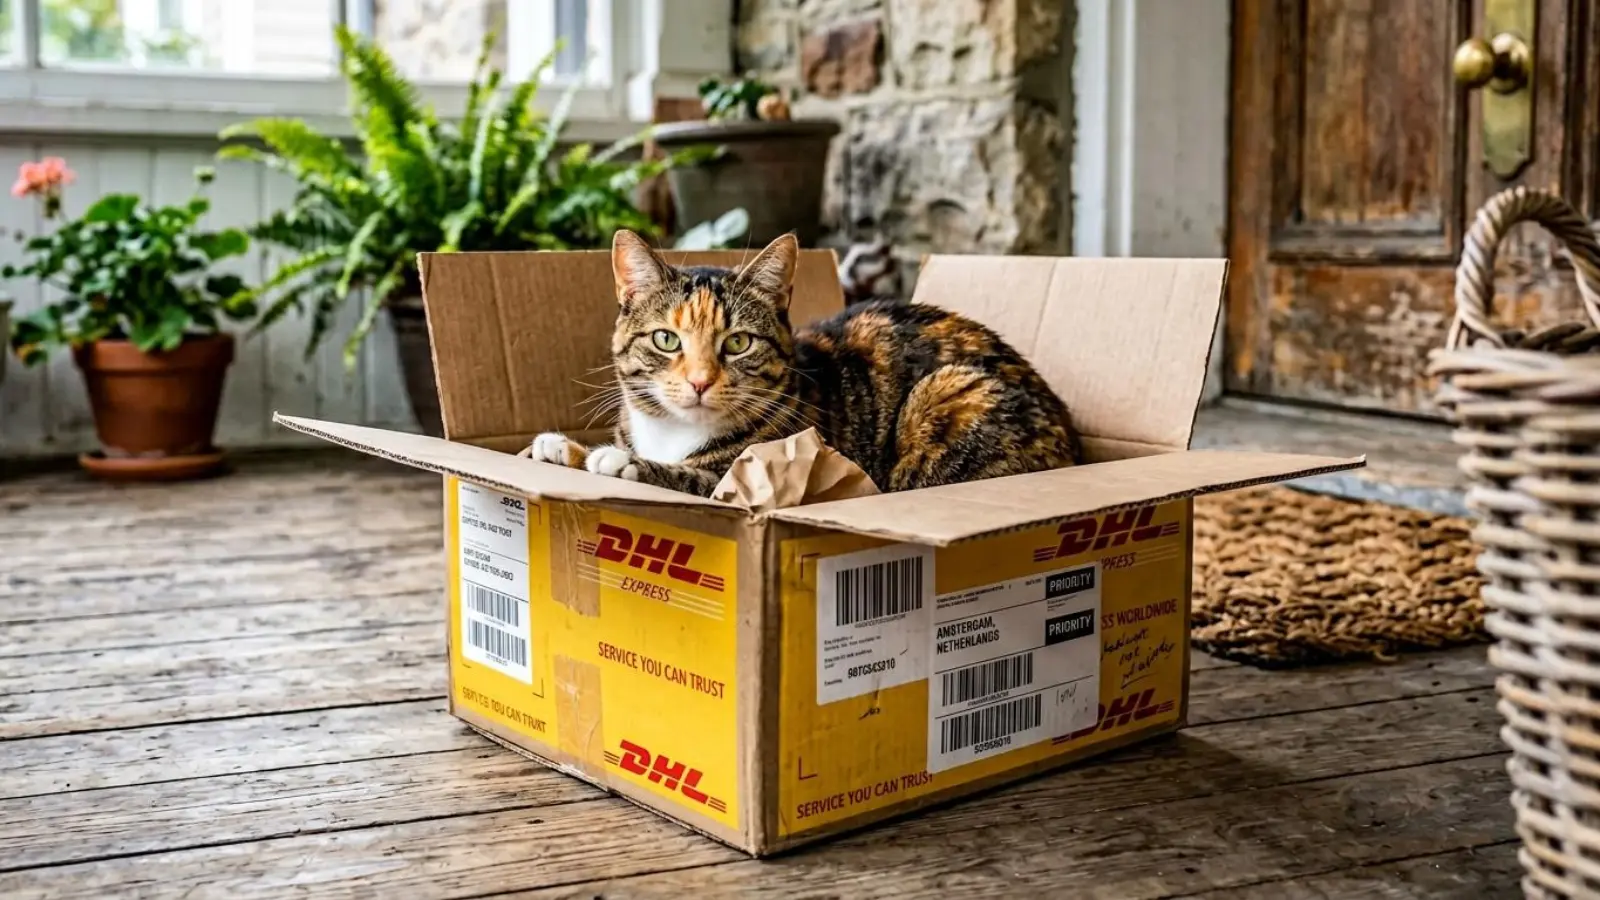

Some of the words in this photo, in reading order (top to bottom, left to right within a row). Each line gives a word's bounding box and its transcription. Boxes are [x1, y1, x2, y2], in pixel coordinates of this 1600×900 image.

[595, 522, 702, 585] DHL
[1055, 505, 1162, 557] DHL
[621, 576, 672, 602] EXPRESS
[598, 641, 638, 669] SERVICE
[640, 655, 662, 677] YOU
[664, 665, 687, 686] CAN
[689, 672, 725, 699] TRUST
[619, 739, 709, 804] DHL
[797, 793, 845, 819] SERVICE
[848, 786, 871, 806] YOU
[875, 779, 898, 796] CAN
